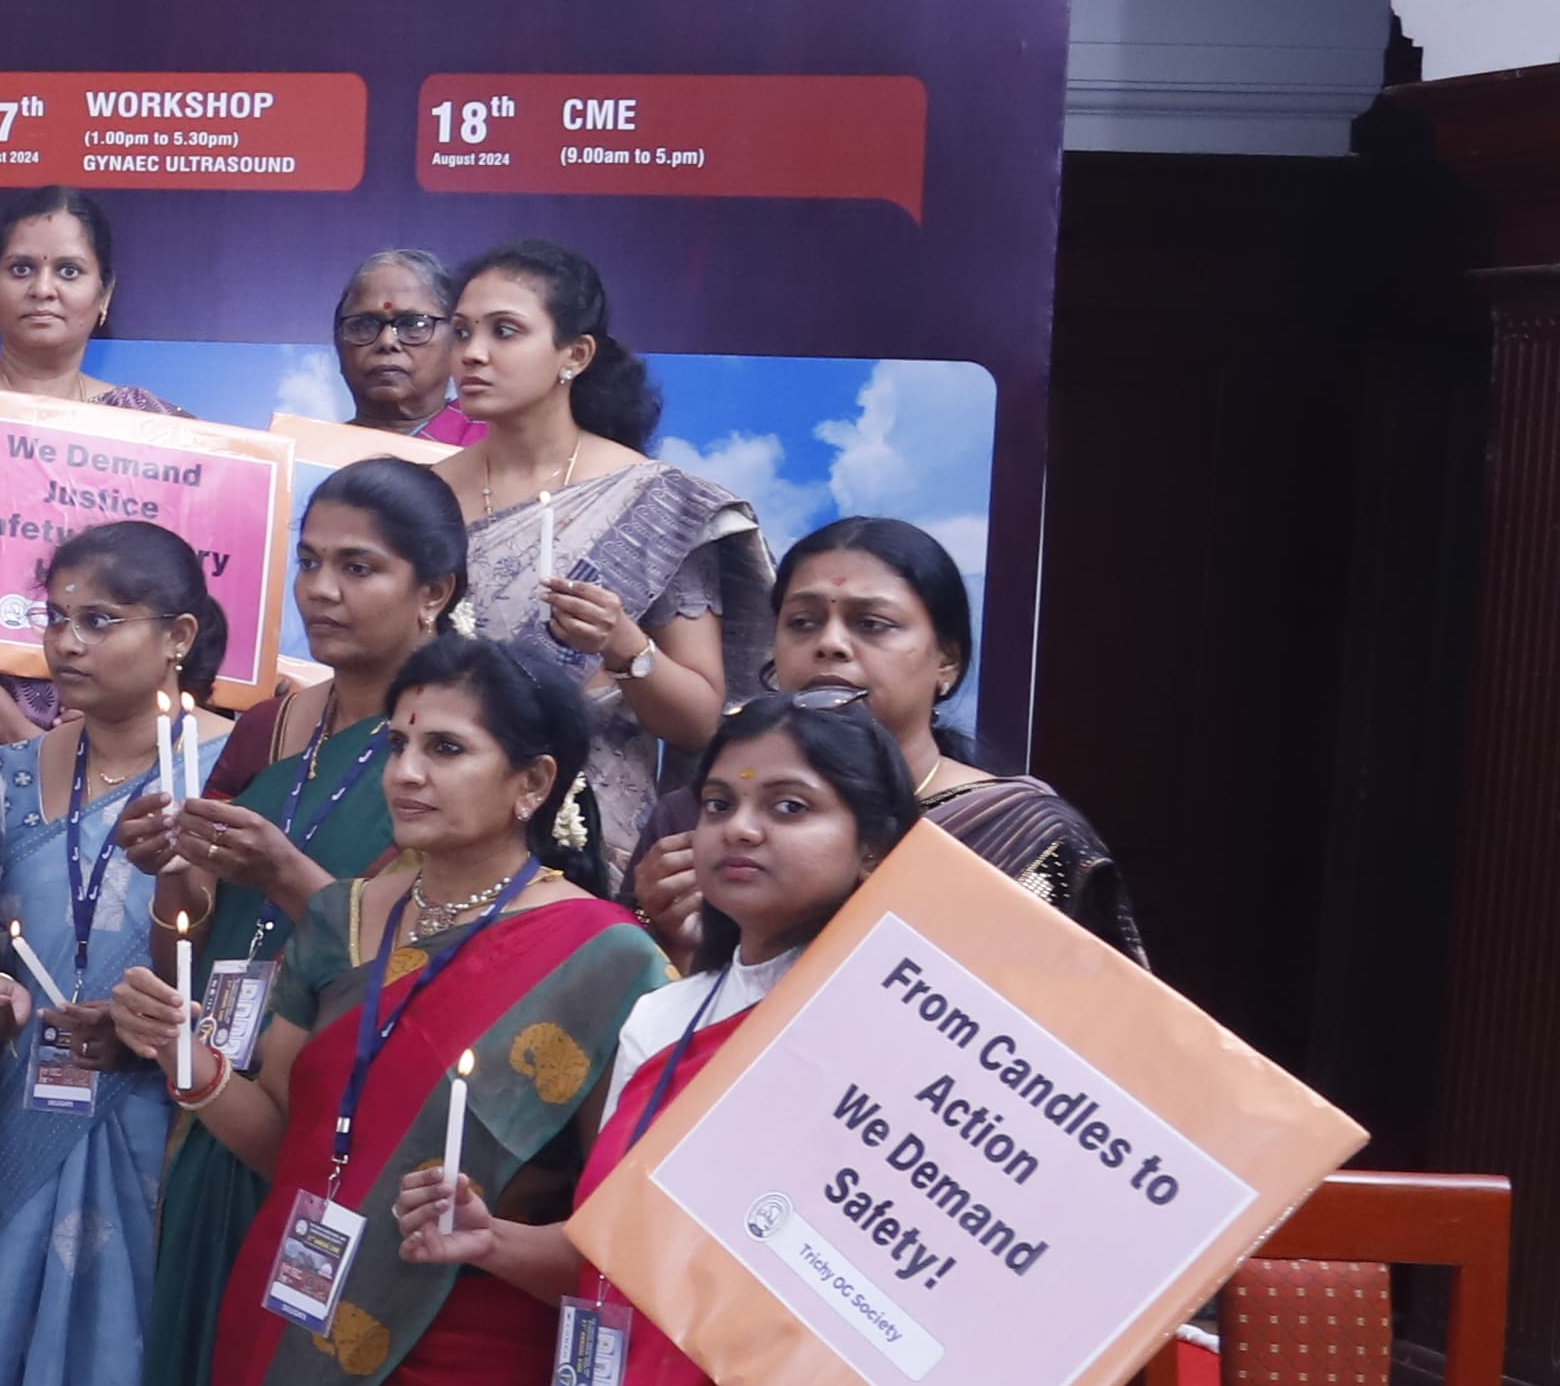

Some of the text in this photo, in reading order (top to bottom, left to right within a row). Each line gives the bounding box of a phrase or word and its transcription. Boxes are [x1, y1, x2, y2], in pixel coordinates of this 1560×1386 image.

[86, 91, 274, 118] WORKSHOP
[431, 95, 515, 143] 18th
[563, 98, 637, 131] CME
[10, 150, 39, 164] 2024
[84, 130, 239, 148] (1.00pm to 5.30pm)
[560, 146, 705, 168] (9.00am to 5.pm)
[83, 155, 296, 173] GYNAEC ULTRASOUND
[432, 152, 510, 168] August 2024
[8, 434, 203, 488] We Demand
[43, 480, 159, 520] Justice
[880, 957, 1180, 1206] From Candles to
[914, 1073, 1040, 1186] Action
[832, 1082, 1049, 1278] We Demand
[824, 1167, 957, 1292] Safety!
